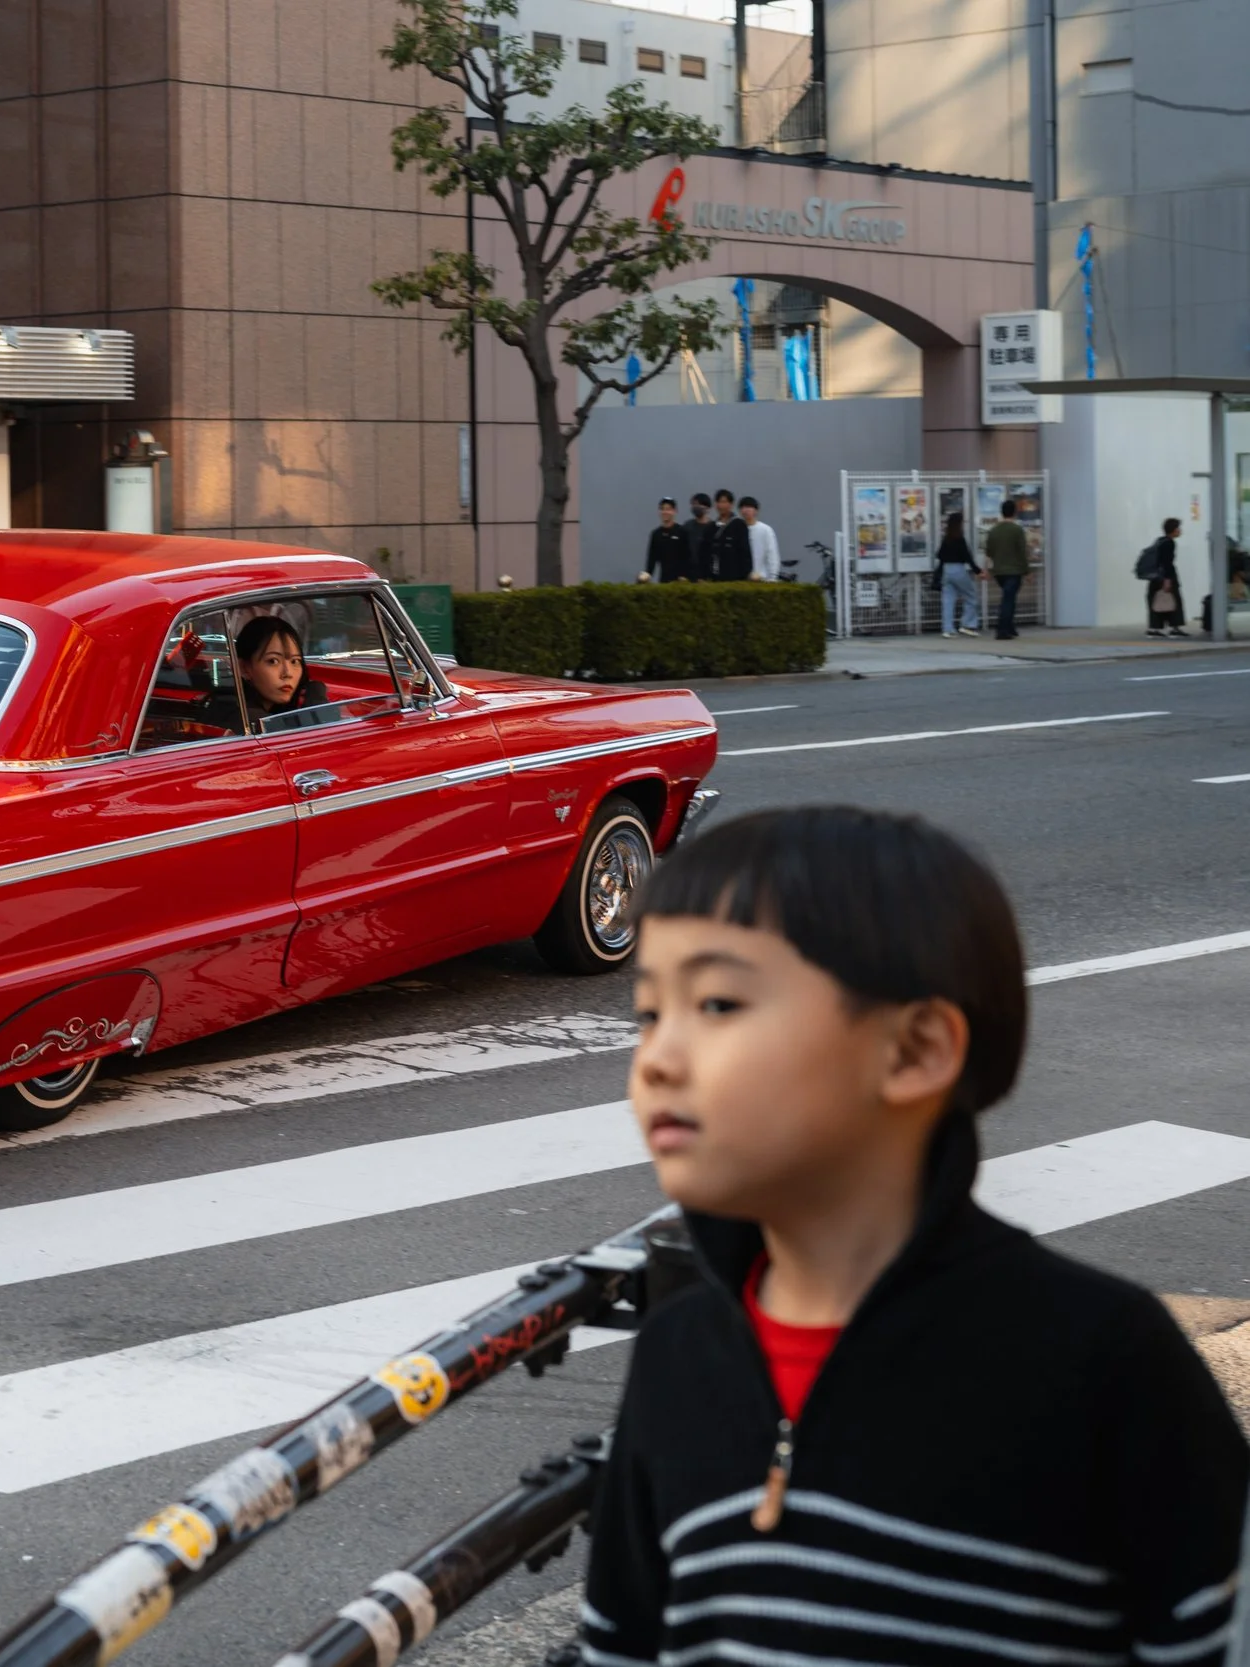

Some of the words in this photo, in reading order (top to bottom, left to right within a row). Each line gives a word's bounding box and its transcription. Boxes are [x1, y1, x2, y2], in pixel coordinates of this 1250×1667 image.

[693, 202, 798, 236] KURASHO
[802, 197, 850, 240] SK
[993, 324, 1031, 342] 専用
[989, 346, 1036, 365] 駐車場
